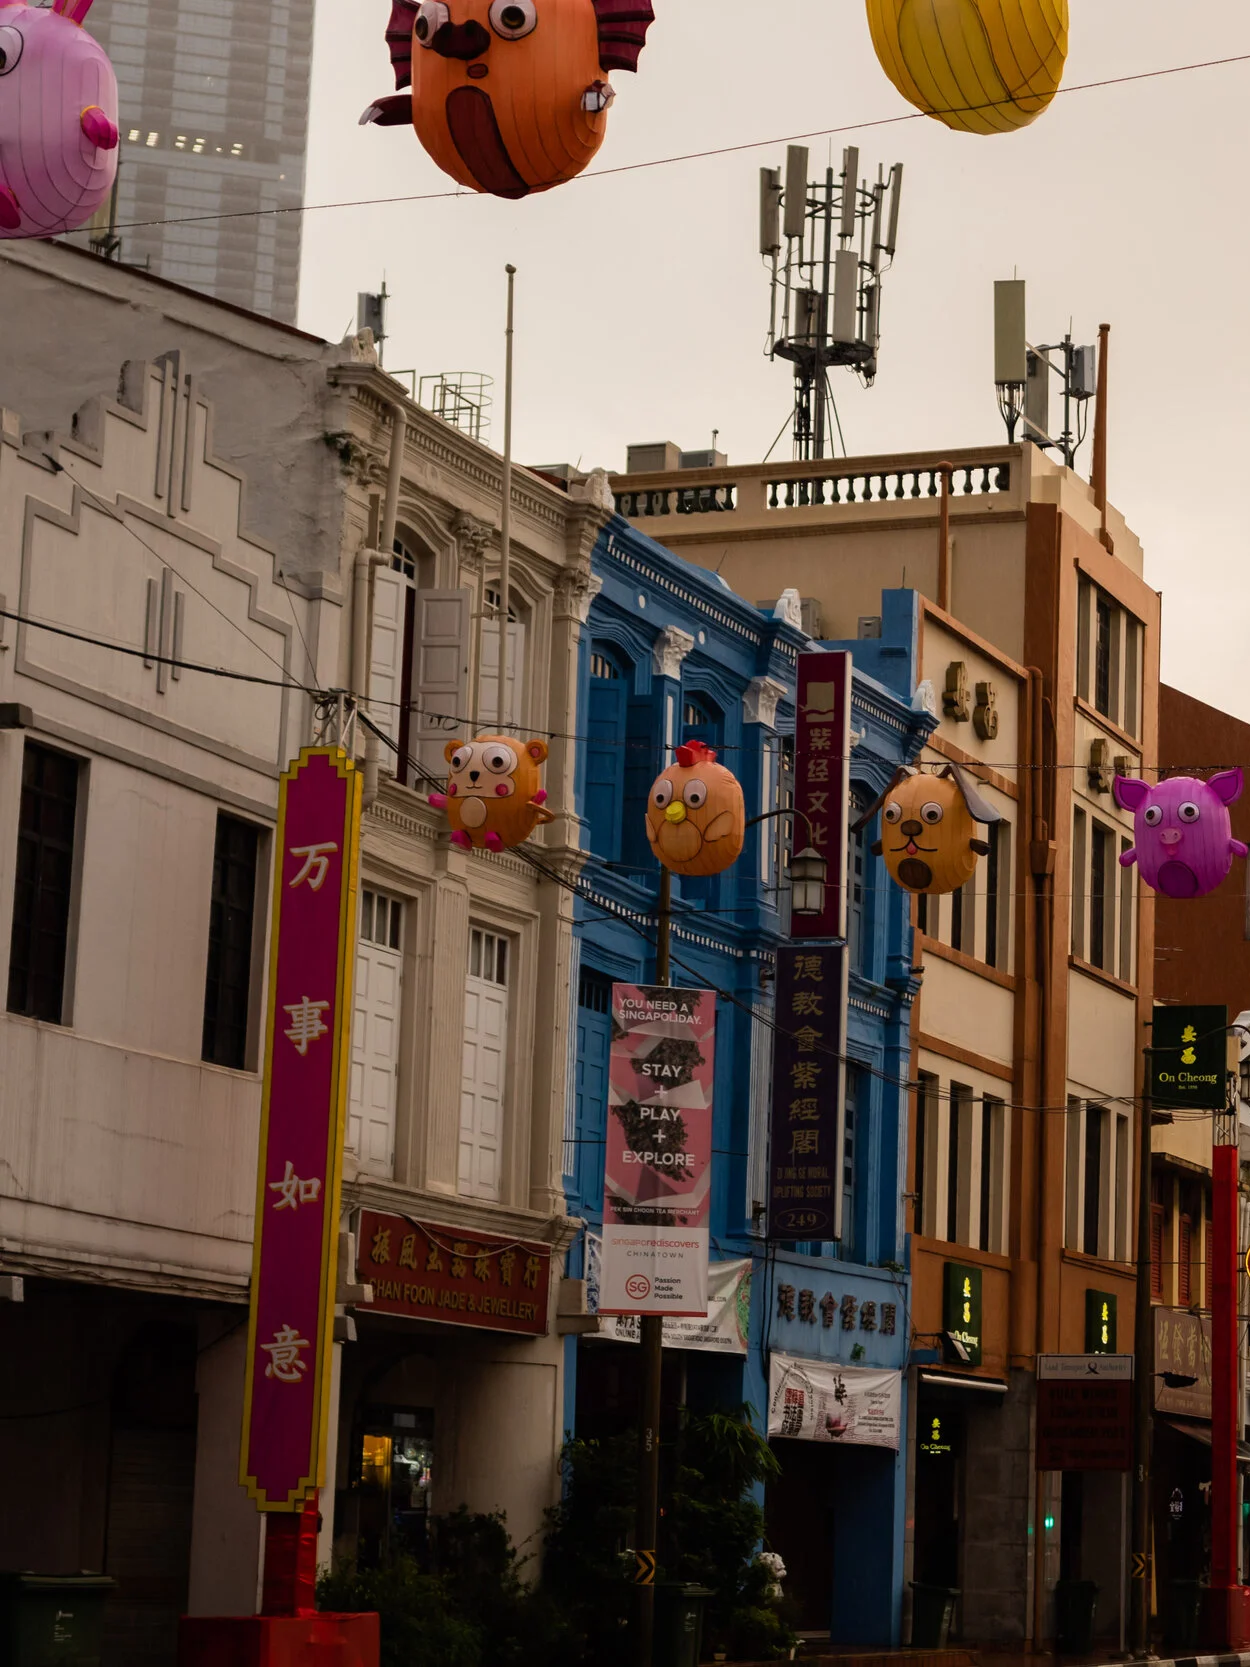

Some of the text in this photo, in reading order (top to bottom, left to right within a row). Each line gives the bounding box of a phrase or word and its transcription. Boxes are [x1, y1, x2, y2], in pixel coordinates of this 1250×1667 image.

[619, 998, 689, 1013] YOU NEED A
[618, 1010, 702, 1025] SINGAPOLIDAY.
[641, 1063, 683, 1078] STAY
[1158, 1071, 1218, 1085] On Cheong
[260, 841, 338, 1383] 万事如意
[640, 1107, 681, 1122] PLAY
[622, 1151, 696, 1167] EXPLORE
[787, 1213, 817, 1227] 249
[626, 1250, 684, 1259] CHINATOWN
[629, 1281, 647, 1293] SG
[654, 1277, 682, 1285] Passion
[368, 1277, 401, 1300] CHAN
[404, 1283, 436, 1305] FOON
[437, 1289, 467, 1311] JADE
[476, 1296, 540, 1321] JEWELLERY
